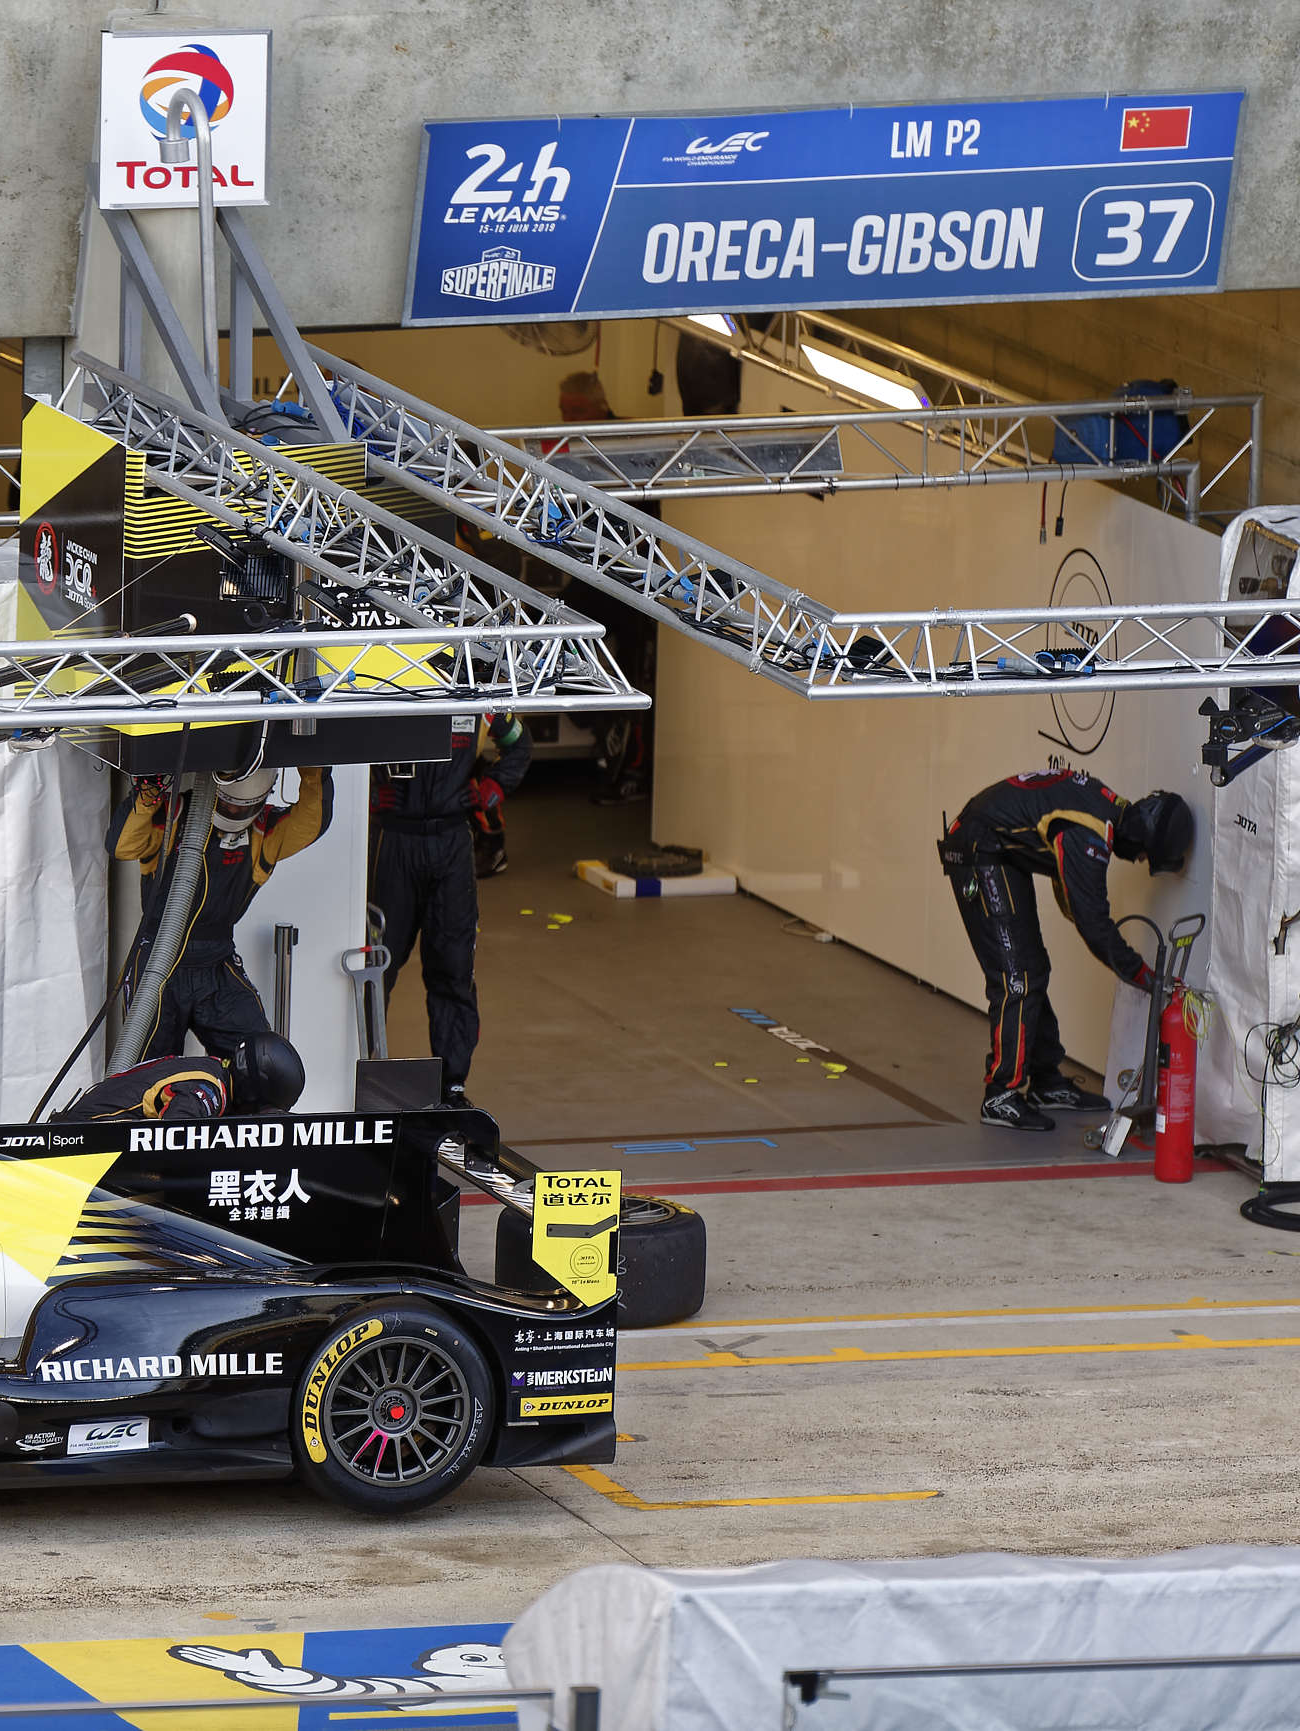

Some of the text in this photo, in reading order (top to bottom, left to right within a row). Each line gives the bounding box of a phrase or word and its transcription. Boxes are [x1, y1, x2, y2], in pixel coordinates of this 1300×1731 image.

[685, 131, 770, 154] WEC
[890, 119, 980, 159] LM P2
[443, 207, 479, 224] LE
[479, 223, 556, 234] 15-16 JUIN 2019
[1095, 198, 1195, 267] 37
[642, 206, 1043, 285] ORECA-GIBSON
[443, 261, 553, 299] SUPERFINALE
[52, 1135, 85, 1149] Sport
[130, 1120, 393, 1152] RICHARD MILLE
[208, 1169, 311, 1207] 黑衣人
[543, 1176, 612, 1188] TOTAL
[542, 1193, 612, 1206] 道达尔
[41, 1353, 283, 1382] RICHARD MILLE
[304, 1322, 370, 1432] DUNLOP
[538, 1399, 609, 1411] DUNLOP
[34, 1431, 55, 1440] ACTION
[86, 1422, 142, 1440] WEC
